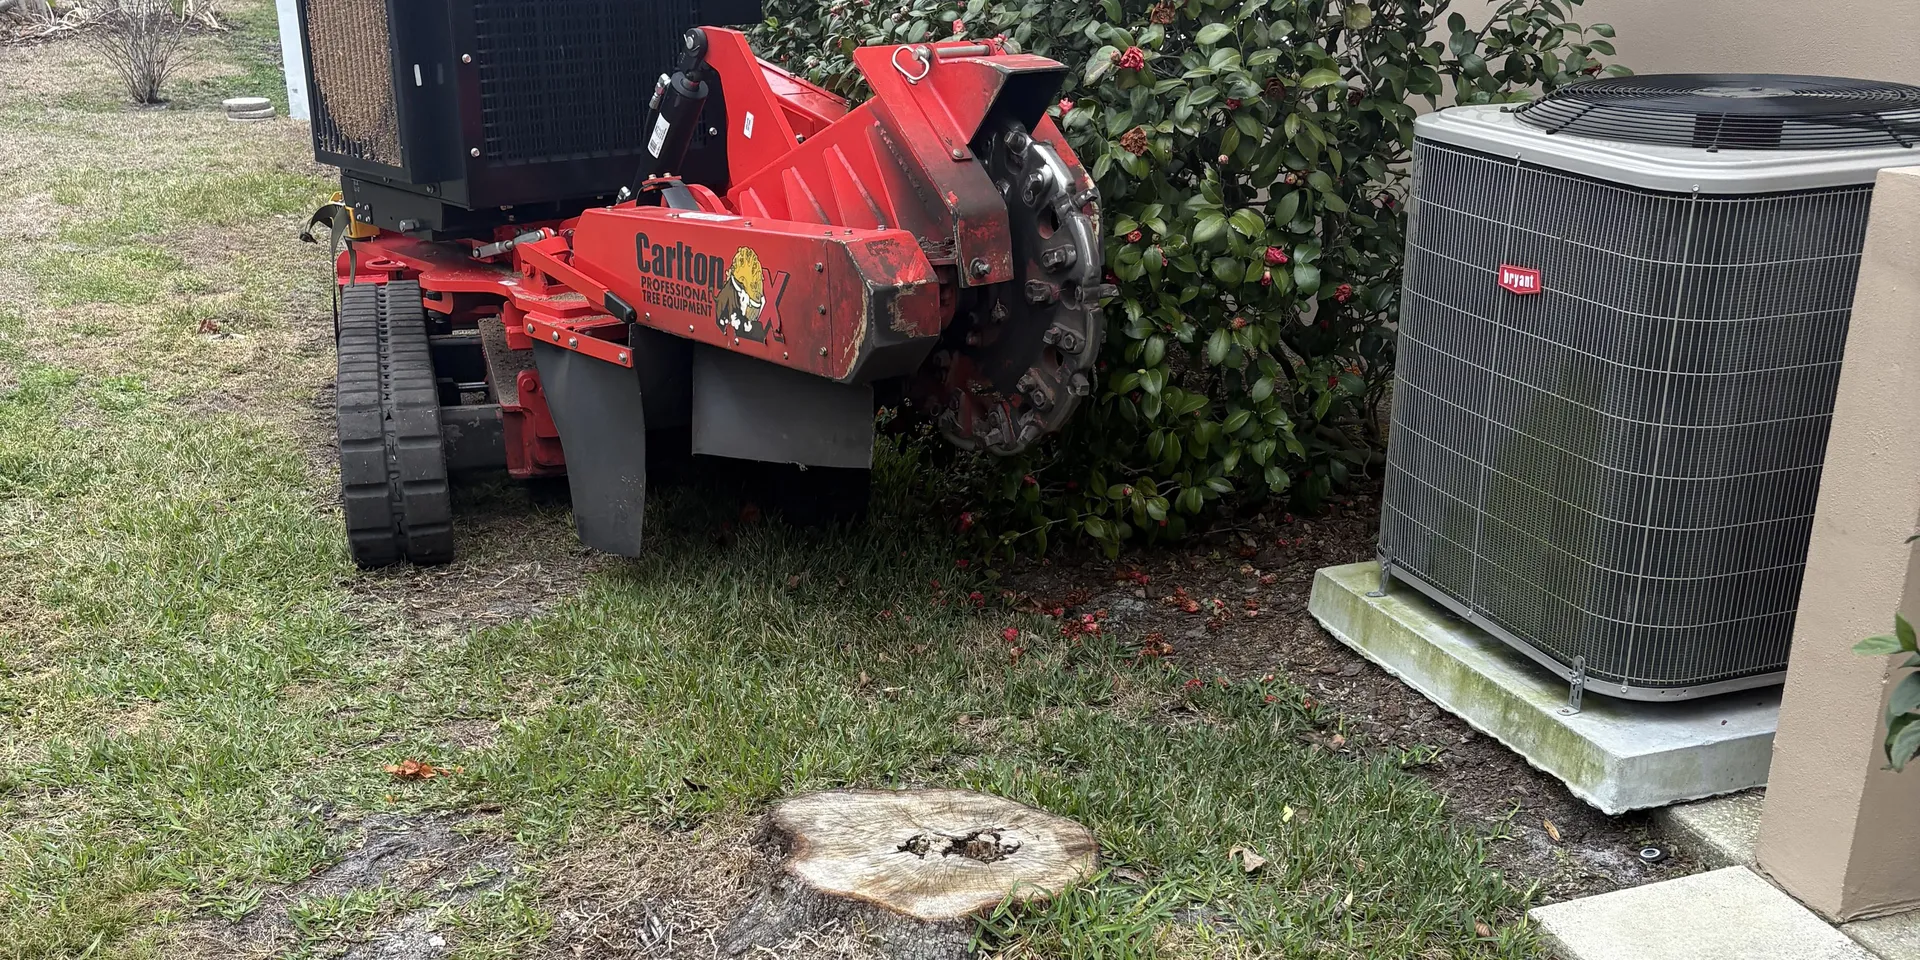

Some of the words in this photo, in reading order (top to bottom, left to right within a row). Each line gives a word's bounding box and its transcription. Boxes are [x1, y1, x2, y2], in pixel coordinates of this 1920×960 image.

[636, 232, 724, 291] Carlton
[641, 276, 713, 304] PROFESSIONAL
[1504, 270, 1533, 288] bryant
[642, 290, 660, 305] TREE
[662, 295, 712, 317] EQUIPMENT
